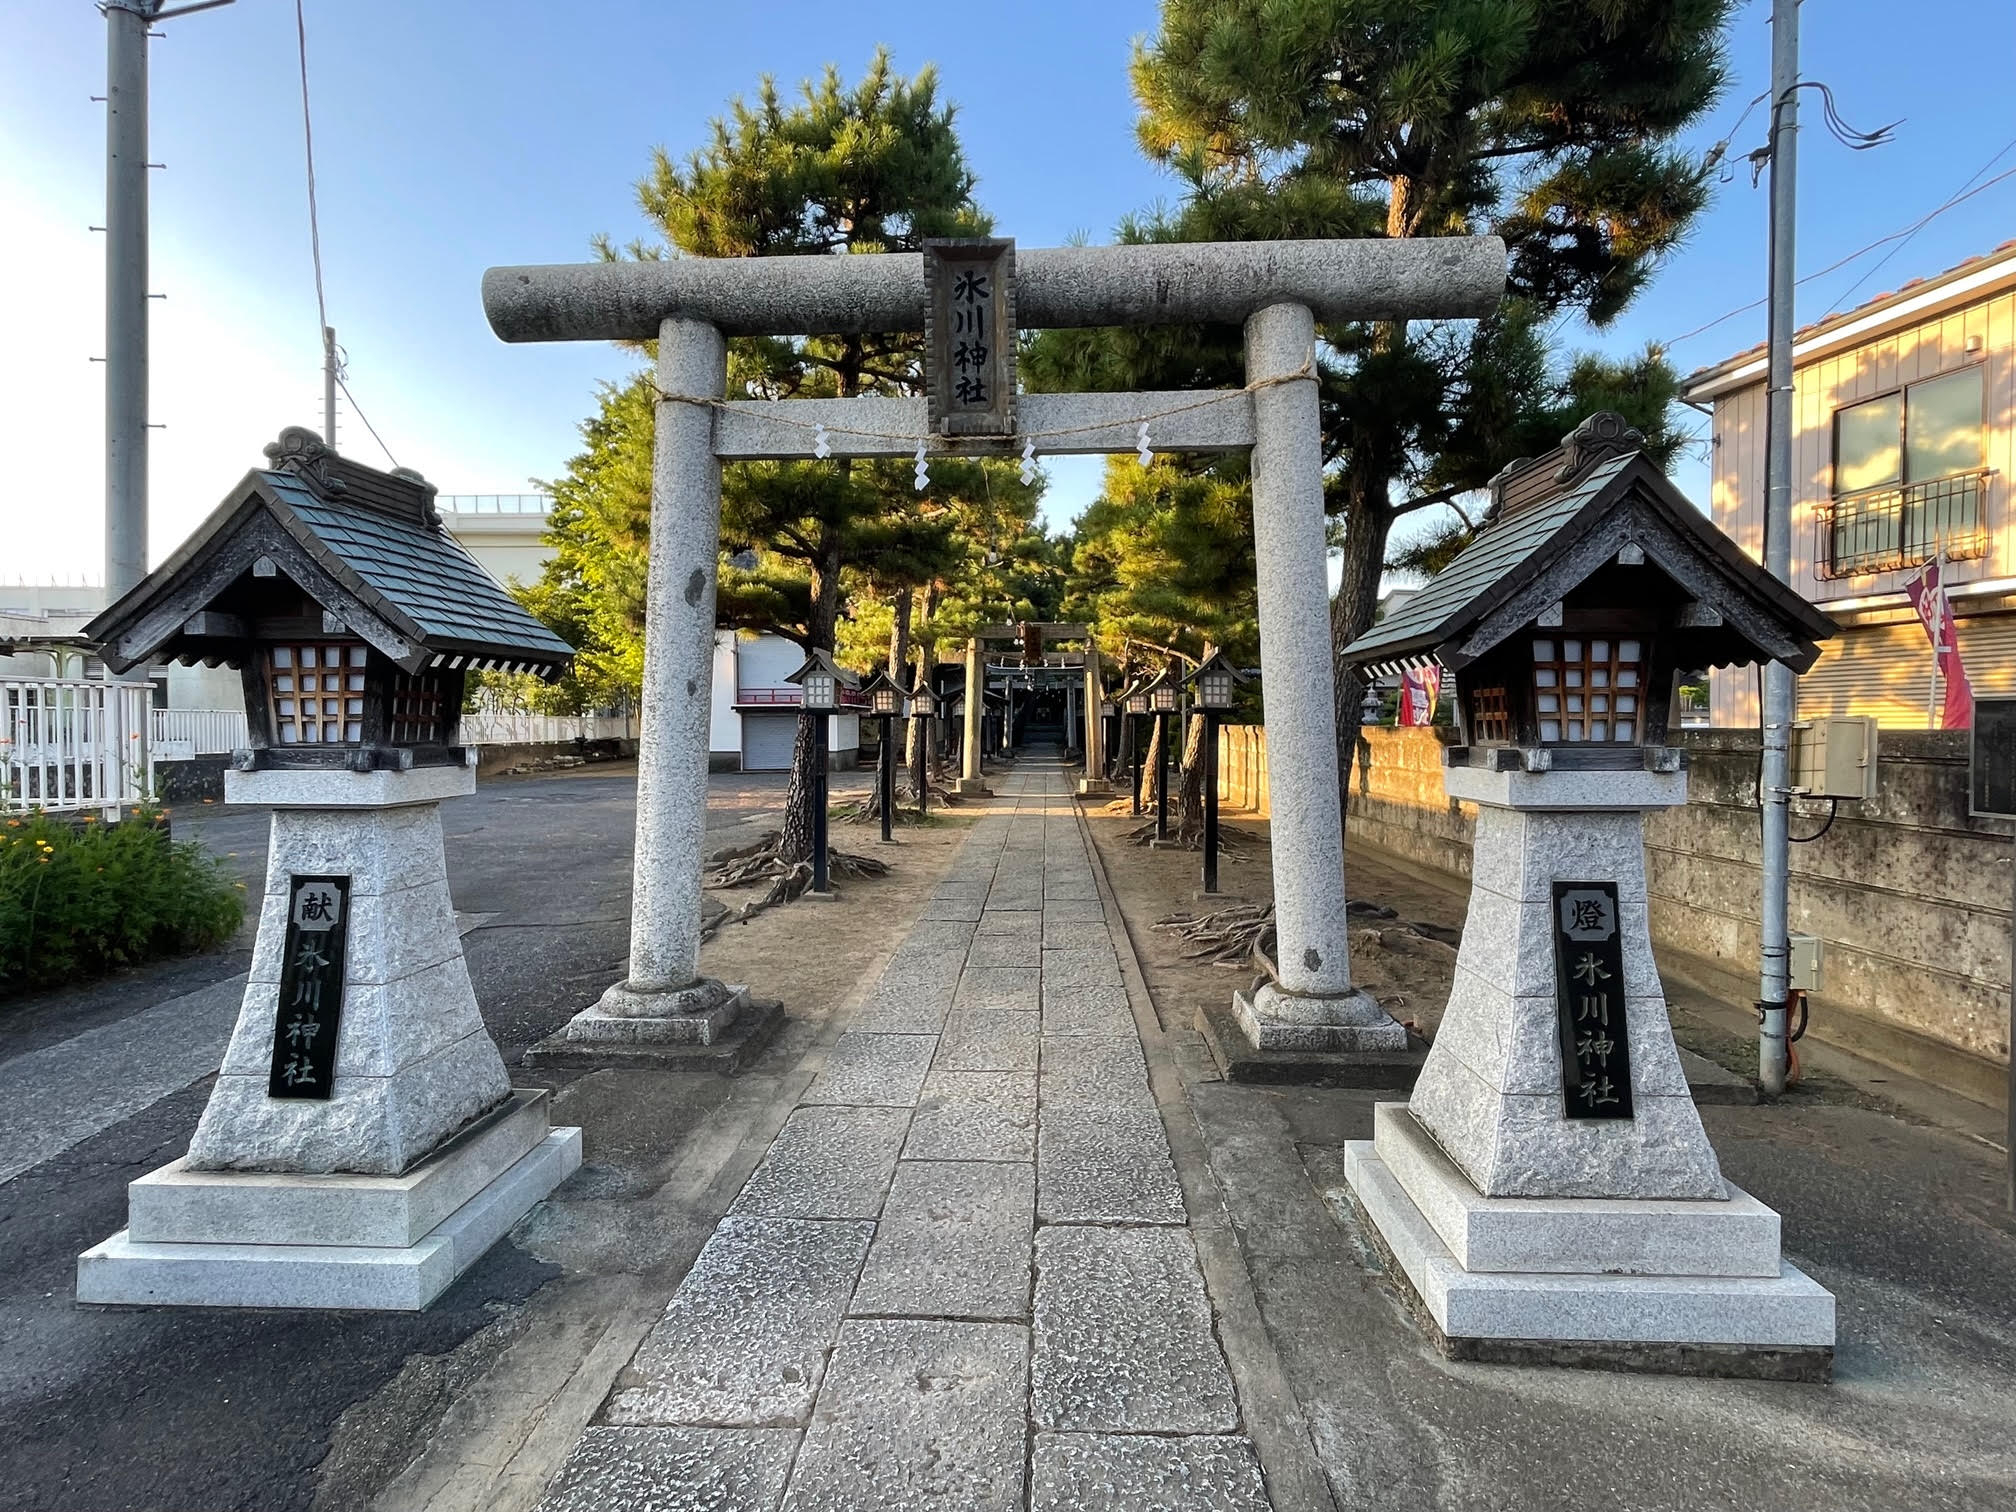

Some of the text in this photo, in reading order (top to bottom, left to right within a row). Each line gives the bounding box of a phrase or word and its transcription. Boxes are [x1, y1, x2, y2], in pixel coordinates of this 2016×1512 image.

[954, 270, 989, 405] 氷川神社
[301, 891, 333, 922] 献
[1570, 899, 1606, 932] 燈
[281, 939, 330, 1087] 氷川神社
[1573, 952, 1619, 1108] 氷川神社
